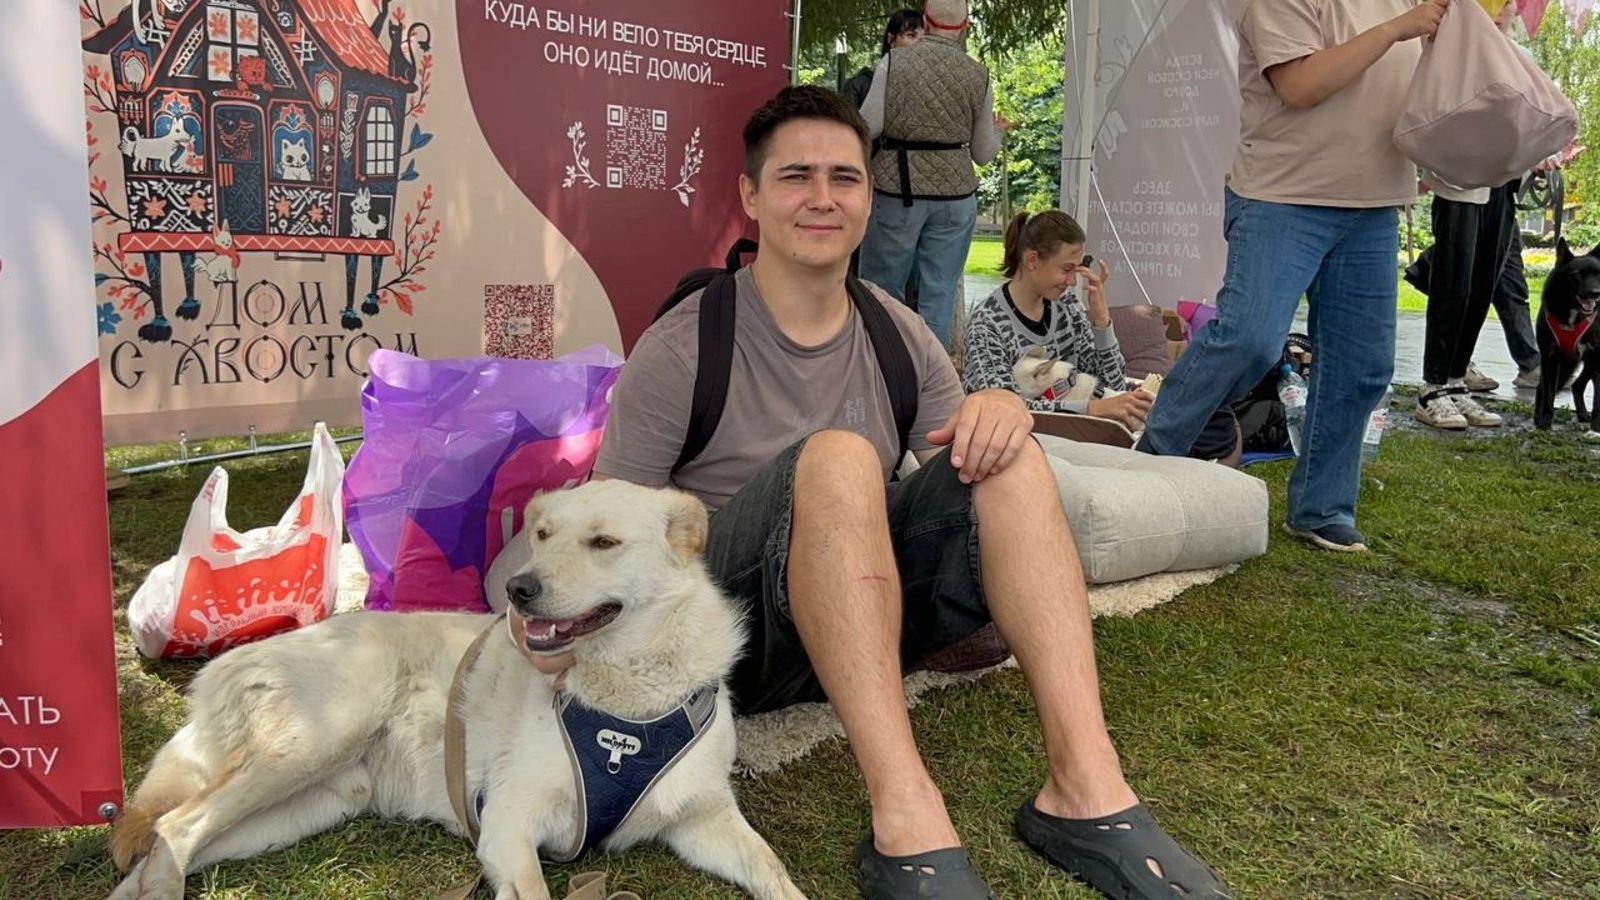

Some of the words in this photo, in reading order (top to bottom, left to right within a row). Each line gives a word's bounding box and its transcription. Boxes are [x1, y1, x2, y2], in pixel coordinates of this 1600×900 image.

[485, 0, 540, 30] КУДА
[546, 9, 574, 34] БЫ
[579, 15, 607, 39] НИ
[613, 21, 659, 47] ВЕЛО
[662, 29, 704, 55] ТЕБЯ
[544, 41, 590, 67] ОНО
[594, 49, 643, 76] ИДЁТ
[646, 57, 725, 87] ДОМОЙ...
[206, 280, 329, 331] ДОМ
[110, 340, 144, 390] С
